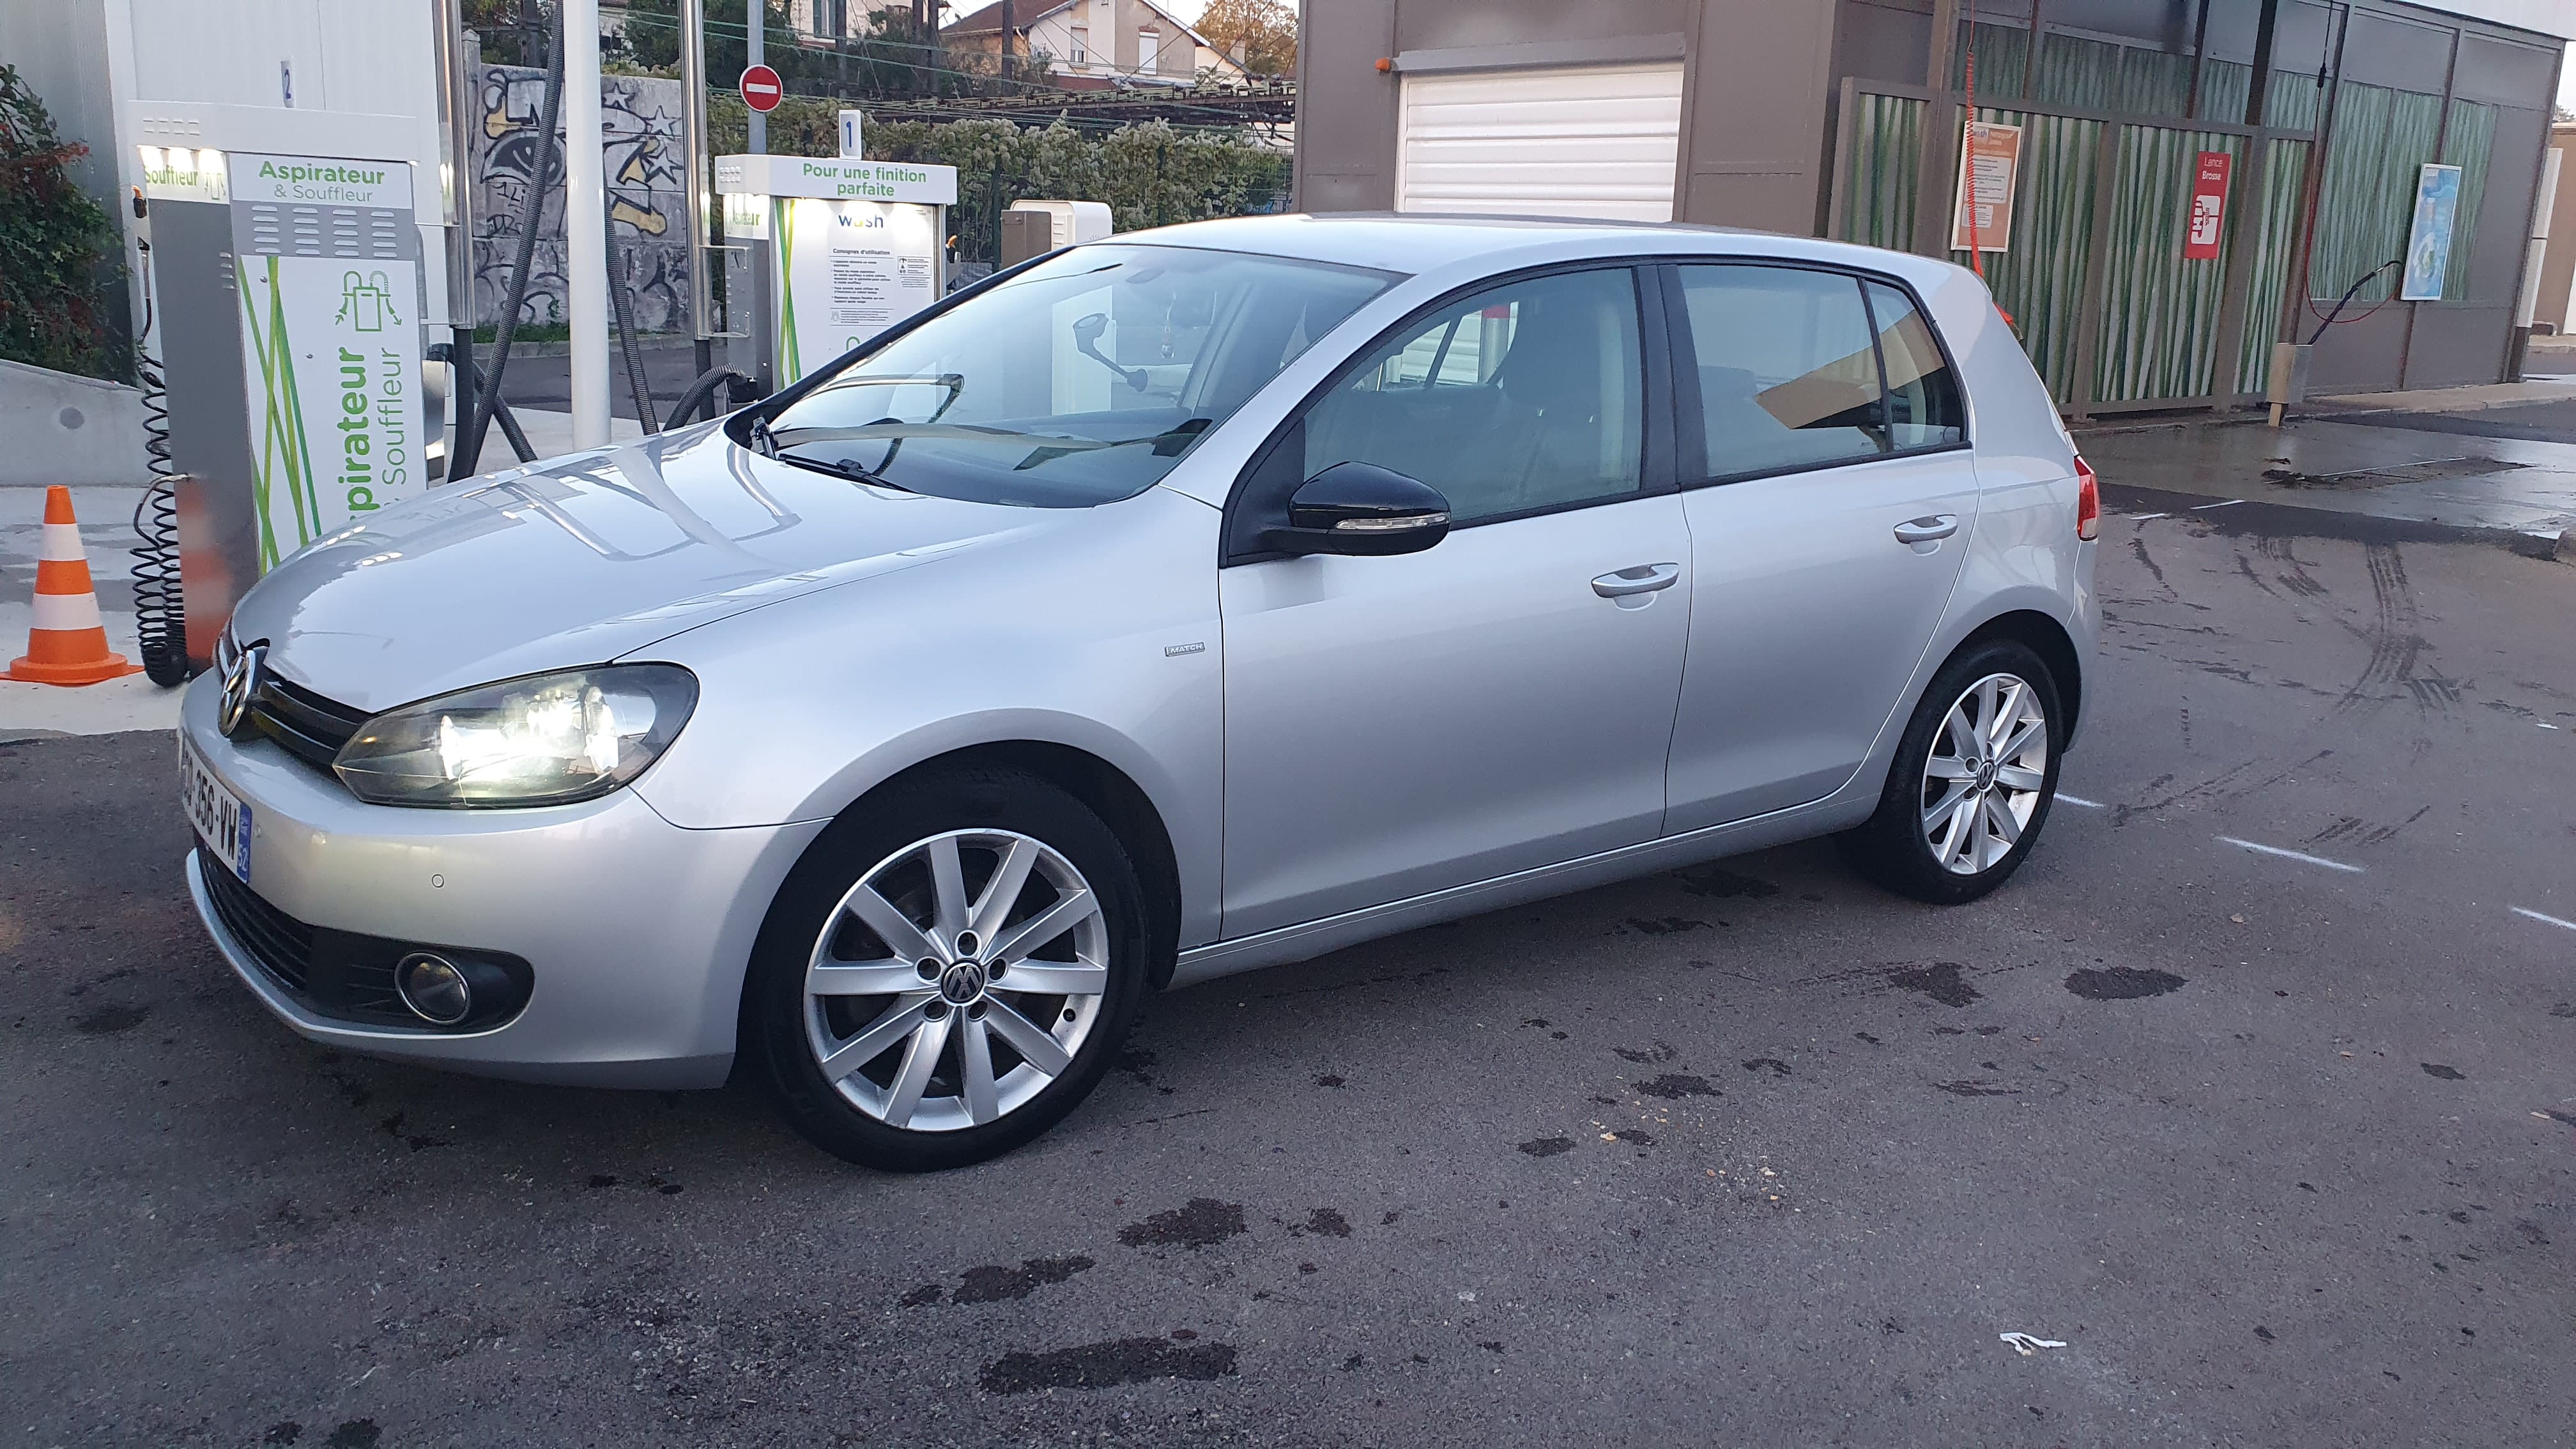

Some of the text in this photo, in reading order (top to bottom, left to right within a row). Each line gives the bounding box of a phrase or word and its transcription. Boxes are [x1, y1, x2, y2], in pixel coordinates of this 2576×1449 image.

[284, 68, 291, 99] 2
[846, 121, 852, 148] 1
[2204, 156, 2223, 167] Lance
[259, 160, 385, 185] Aspirateur
[803, 163, 926, 182] Pour une finition
[2202, 170, 2221, 180] Brosse
[274, 184, 373, 202] & Souffleur
[837, 181, 894, 196] parfaite
[377, 347, 407, 485] Souffleur
[1170, 643, 1202, 654] MATCH
